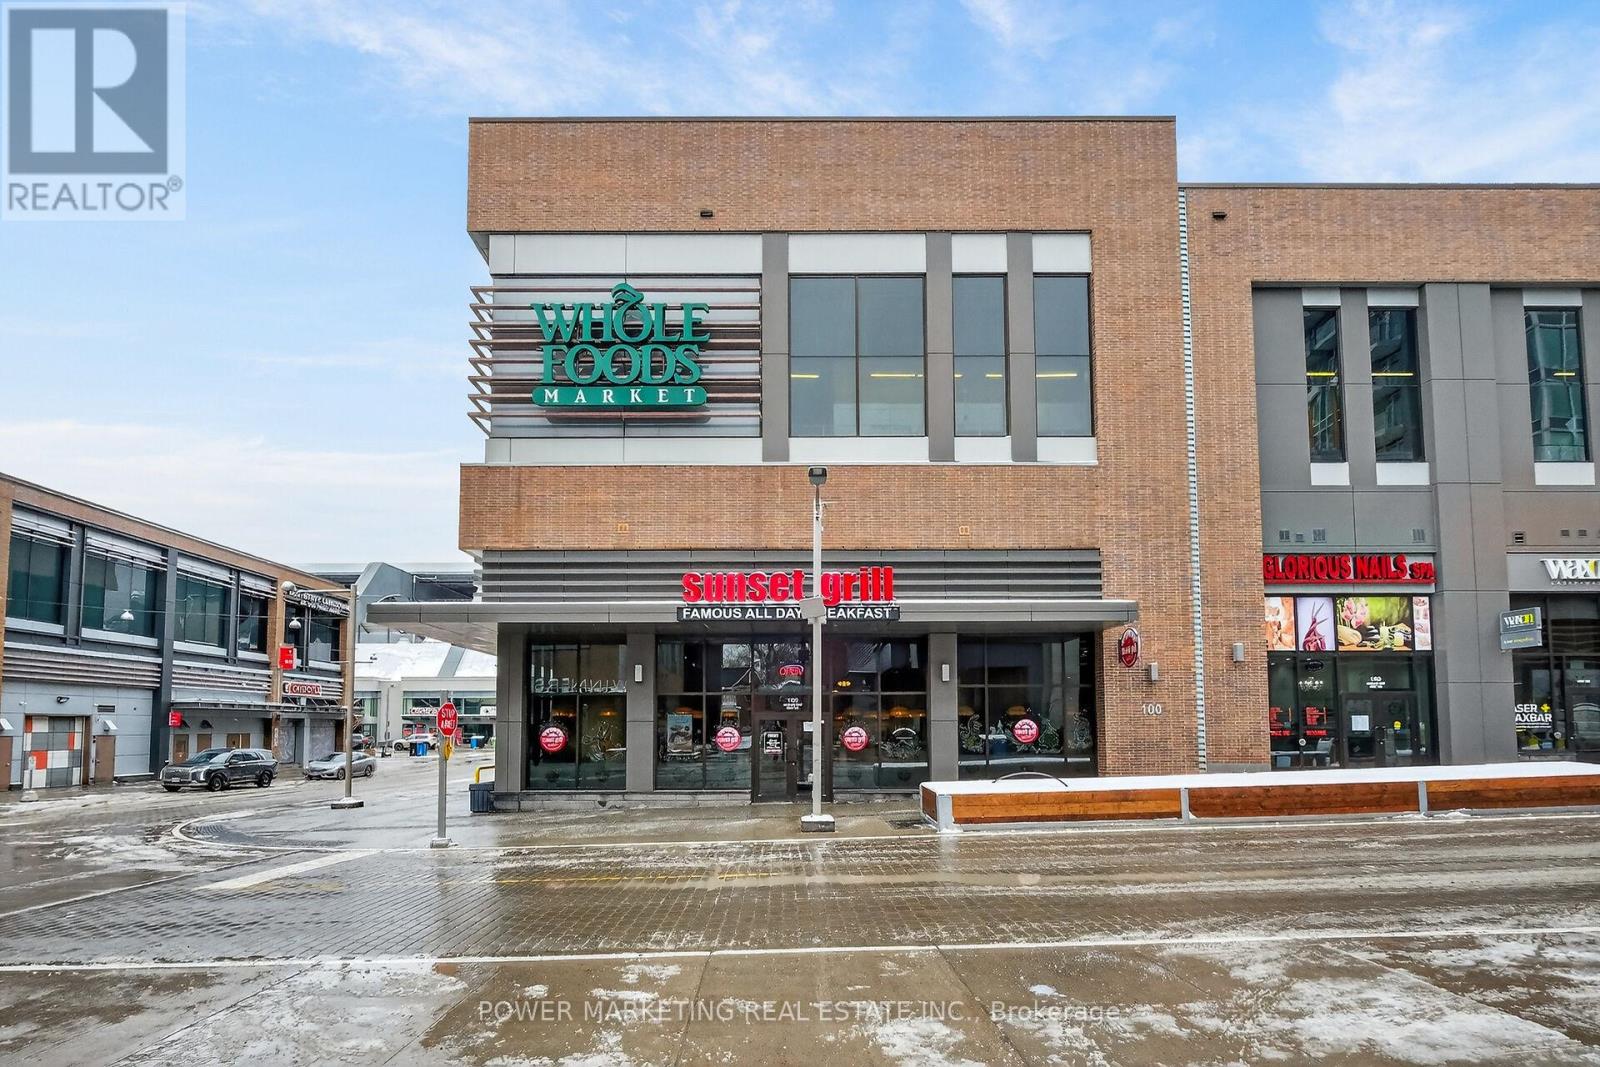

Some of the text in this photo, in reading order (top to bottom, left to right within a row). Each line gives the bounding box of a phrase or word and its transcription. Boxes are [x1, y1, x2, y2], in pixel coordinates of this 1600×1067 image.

[530, 284, 711, 343] WHOLE
[536, 344, 704, 385] FOODS
[544, 388, 696, 403] MARKET
[1263, 554, 1436, 580] GLORIOUS NAILS SPA
[681, 566, 894, 606] sunset grill
[683, 607, 892, 619] FAMOUS ALL DAY EAKFAST
[441, 708, 456, 719] STOP
[1142, 703, 1162, 715] 100
